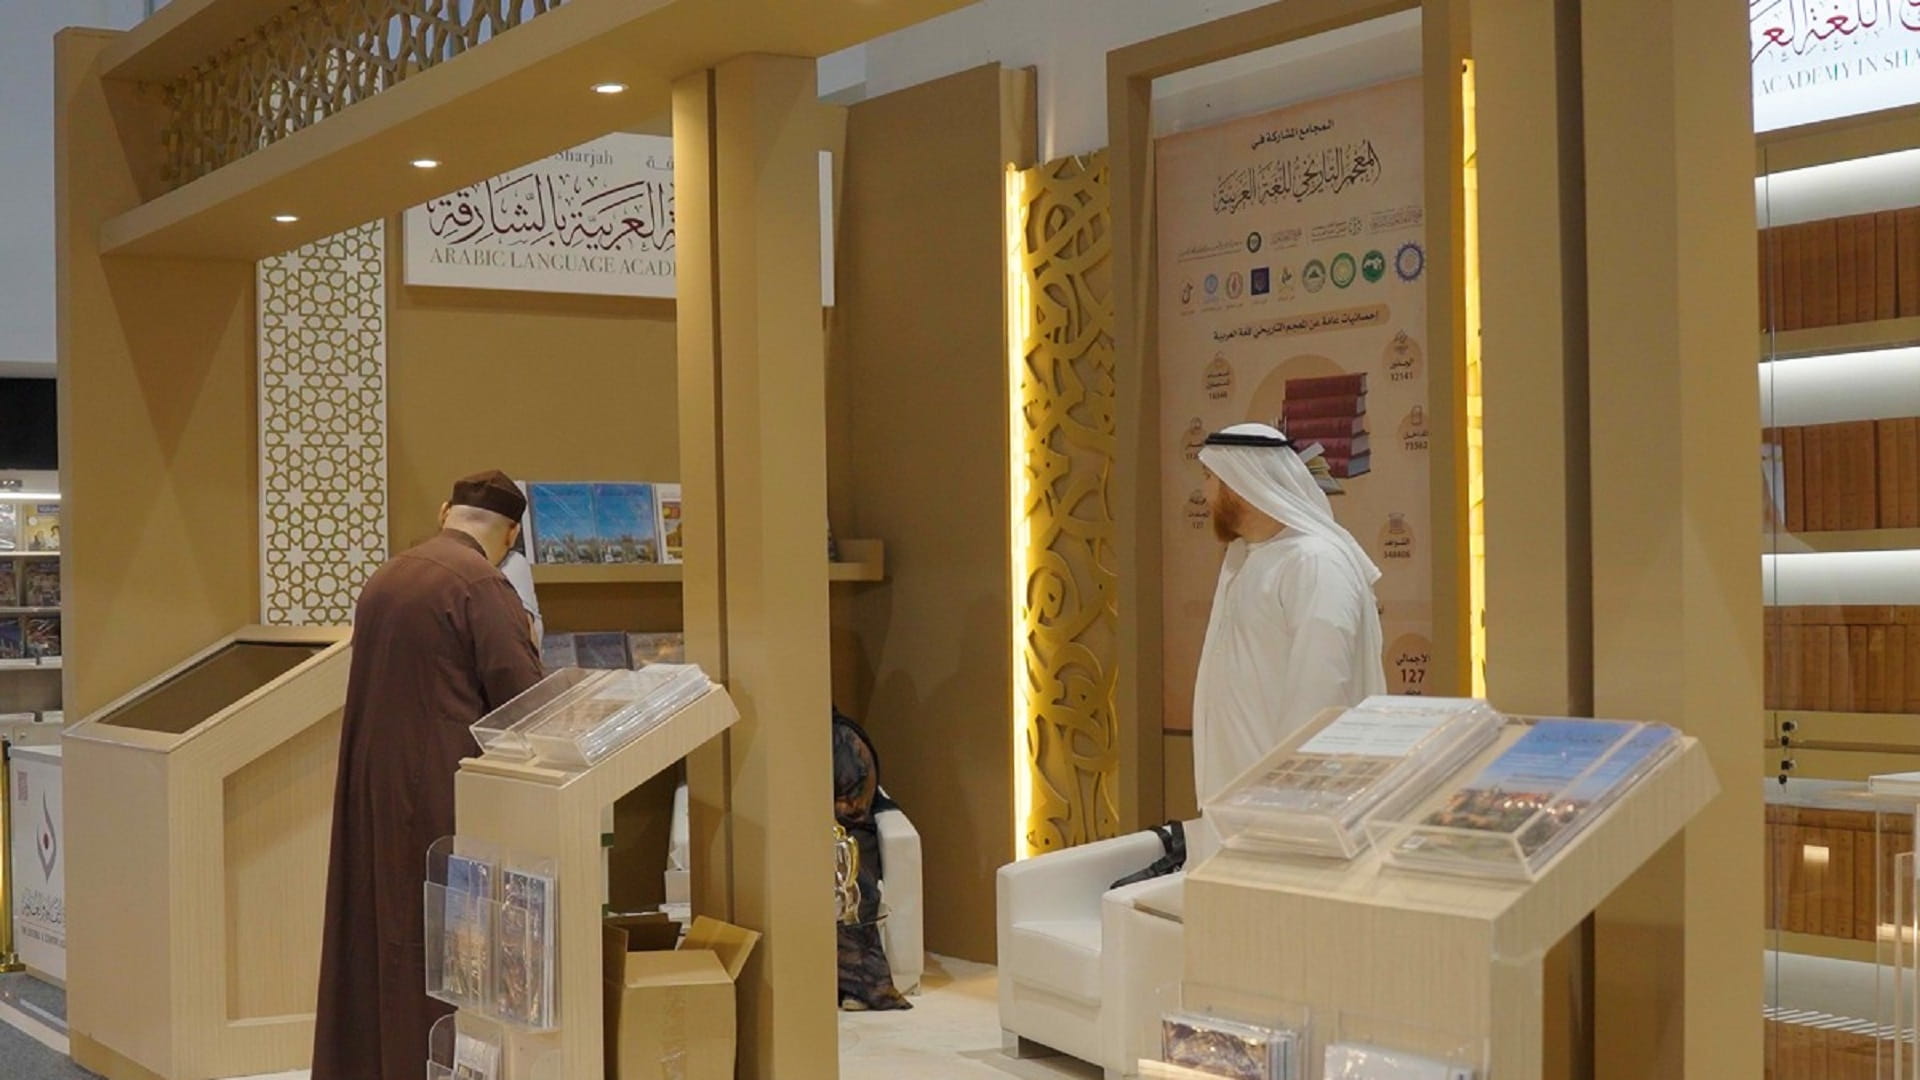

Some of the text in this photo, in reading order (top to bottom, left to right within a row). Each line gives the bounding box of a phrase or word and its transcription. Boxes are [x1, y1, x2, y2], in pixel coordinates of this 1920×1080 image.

[1758, 63, 1850, 95] ACADEMY
[1857, 57, 1879, 76] IN
[1251, 133, 1265, 151] في
[429, 247, 674, 277] ARABIC LANGUAGE ACAD
[1401, 669, 1425, 683] 127
